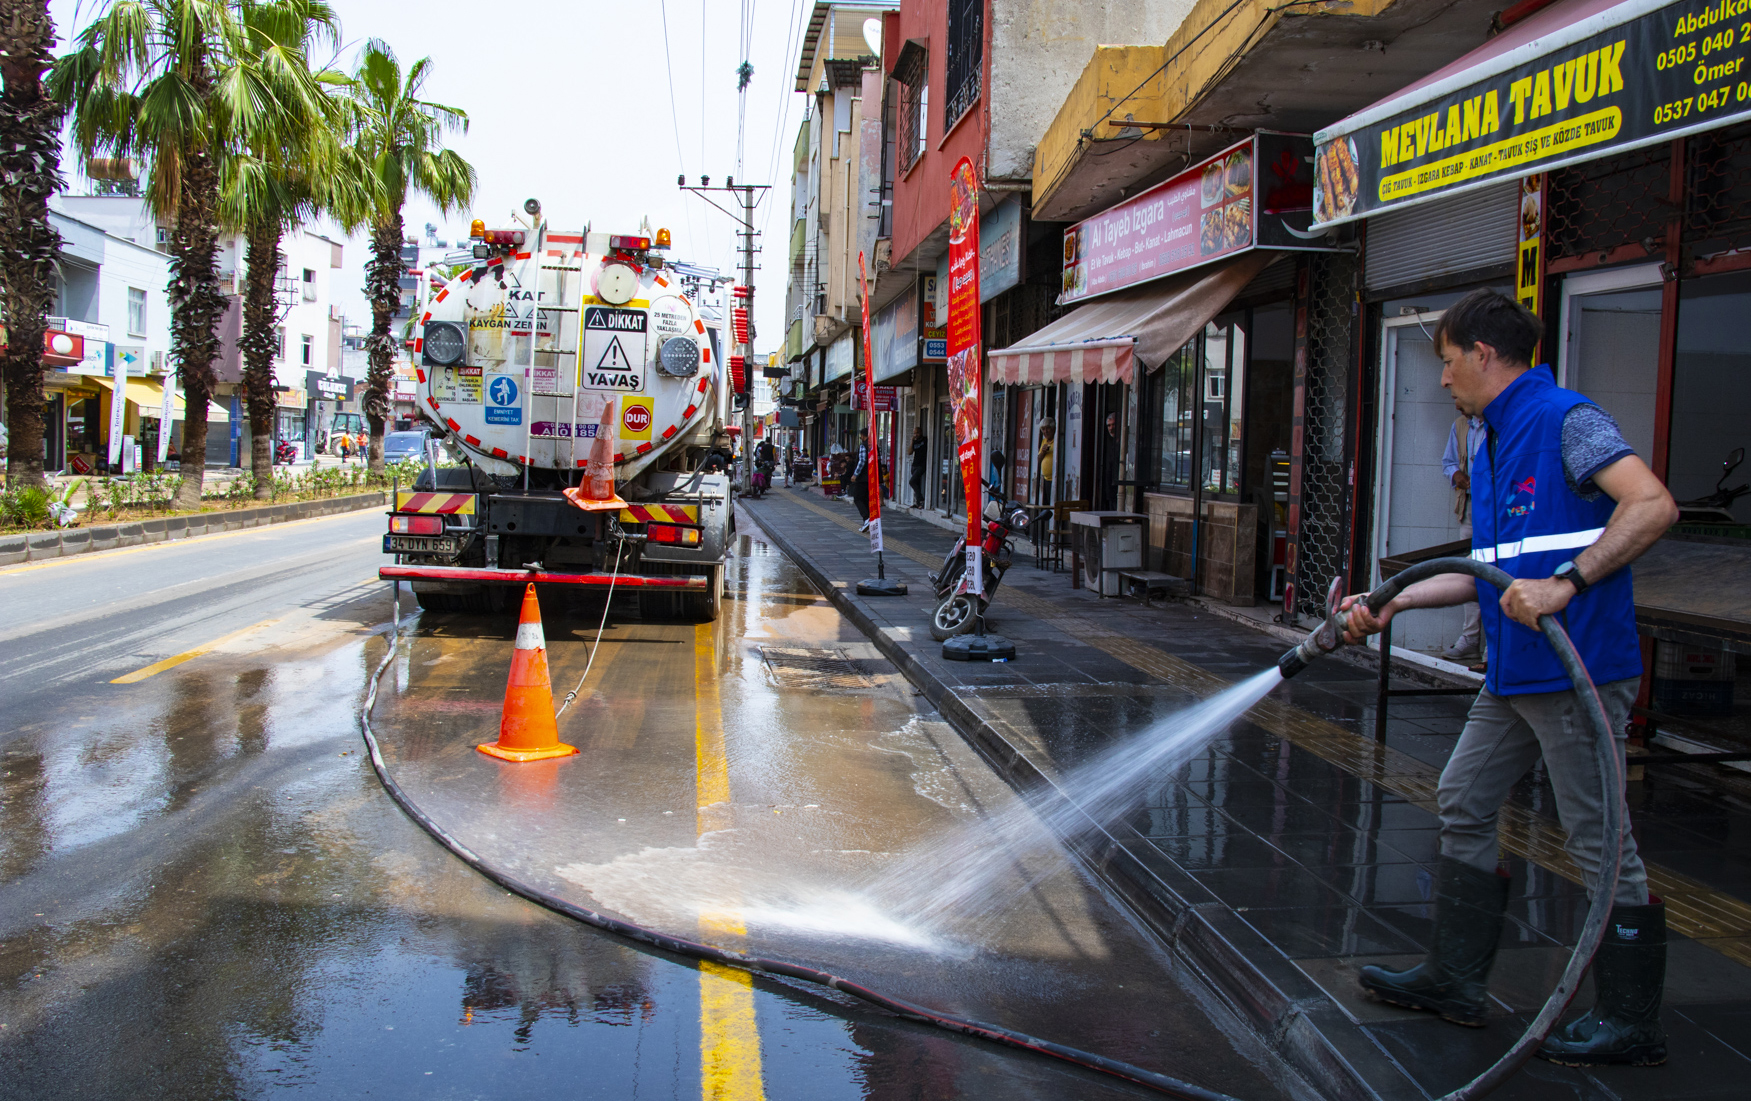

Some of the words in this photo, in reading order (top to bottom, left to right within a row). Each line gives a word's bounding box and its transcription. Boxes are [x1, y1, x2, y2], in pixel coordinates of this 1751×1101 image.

[1674, 0, 1751, 38] Abdulka
[1656, 41, 1697, 71] 0505
[1701, 28, 1734, 56] 040
[1693, 57, 1744, 85] Ömer
[1380, 89, 1500, 169] MEVLANA
[1509, 39, 1626, 125] TAVUK
[1653, 97, 1694, 125] 0537
[1697, 86, 1731, 112] 047
[1736, 81, 1751, 102] 0
[1392, 175, 1413, 192] TAVUK
[1441, 161, 1464, 179] KEBAP
[1469, 152, 1493, 170] KANAT
[1498, 143, 1523, 162] TAVUK
[1525, 137, 1538, 157] ŞİŞ
[1540, 135, 1551, 149] VE
[1552, 126, 1582, 146] KÖZDE
[1584, 115, 1616, 137] TAVUK
[1092, 222, 1102, 249] Al
[1103, 211, 1130, 247] Tayeb
[1133, 200, 1164, 235] Izgara
[1102, 250, 1114, 267] Tavuk
[1117, 246, 1131, 261] Kebap
[1146, 235, 1160, 250] Kanat
[1164, 223, 1193, 243] Lahmacun
[469, 319, 511, 329] KAYGAN
[607, 310, 644, 330] DİKKAT
[459, 367, 481, 376] KKAT
[587, 372, 640, 390] YAVAŞ
[626, 414, 648, 424] DUR
[391, 537, 404, 550] 34
[408, 538, 428, 550] DYN
[432, 538, 452, 551] 659
